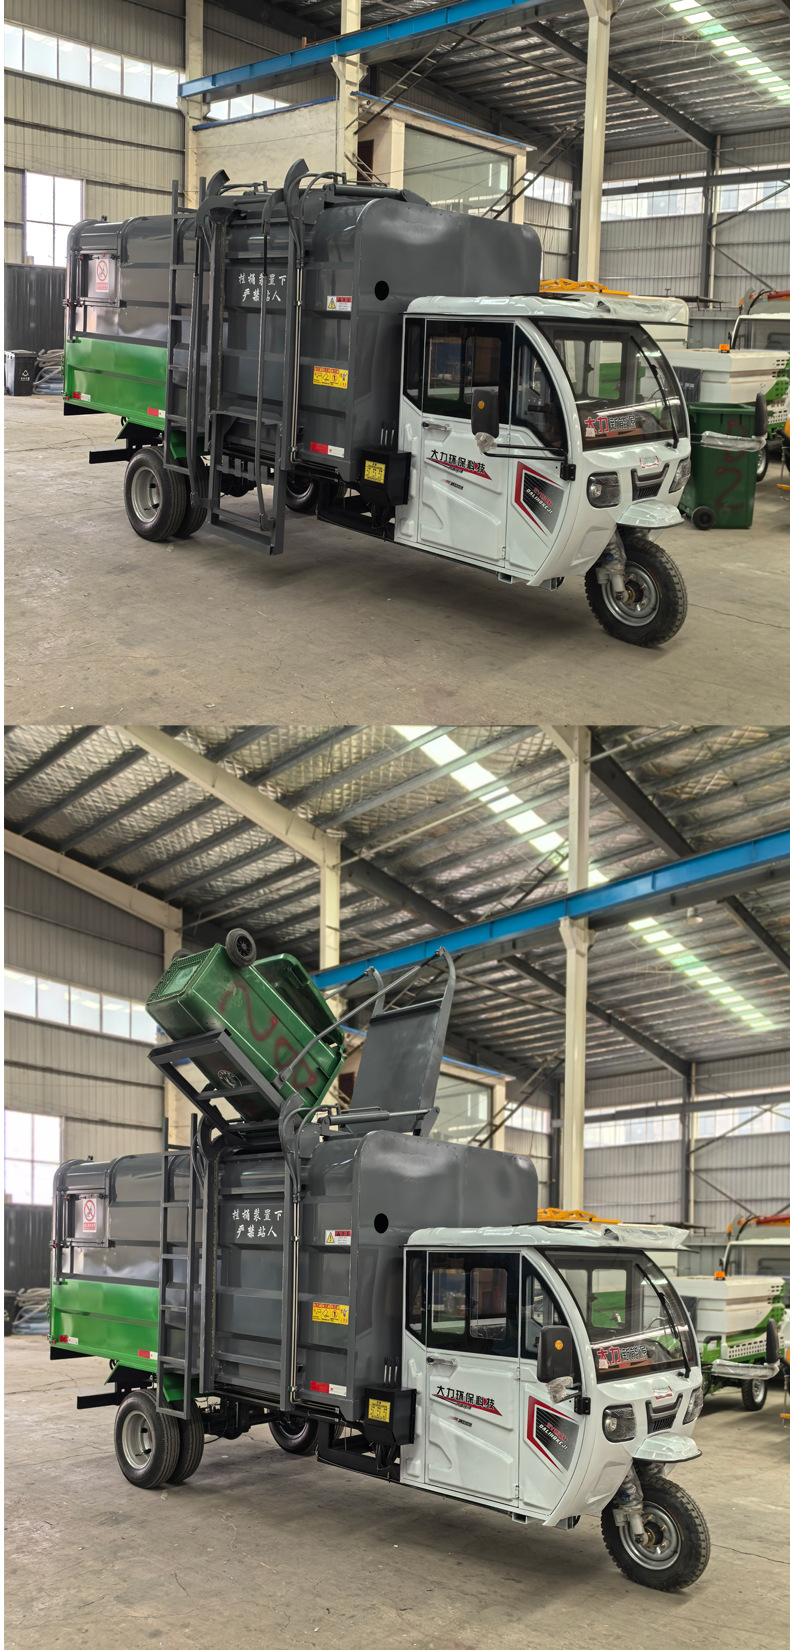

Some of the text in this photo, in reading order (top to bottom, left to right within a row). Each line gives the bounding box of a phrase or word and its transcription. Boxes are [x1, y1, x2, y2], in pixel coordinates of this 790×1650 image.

[430, 449, 486, 474] 大力环保科技
[232, 1208, 283, 1222] 挂桶装置下
[236, 1224, 278, 1239] 严禁站人
[436, 1385, 495, 1410] 大力环保科技
